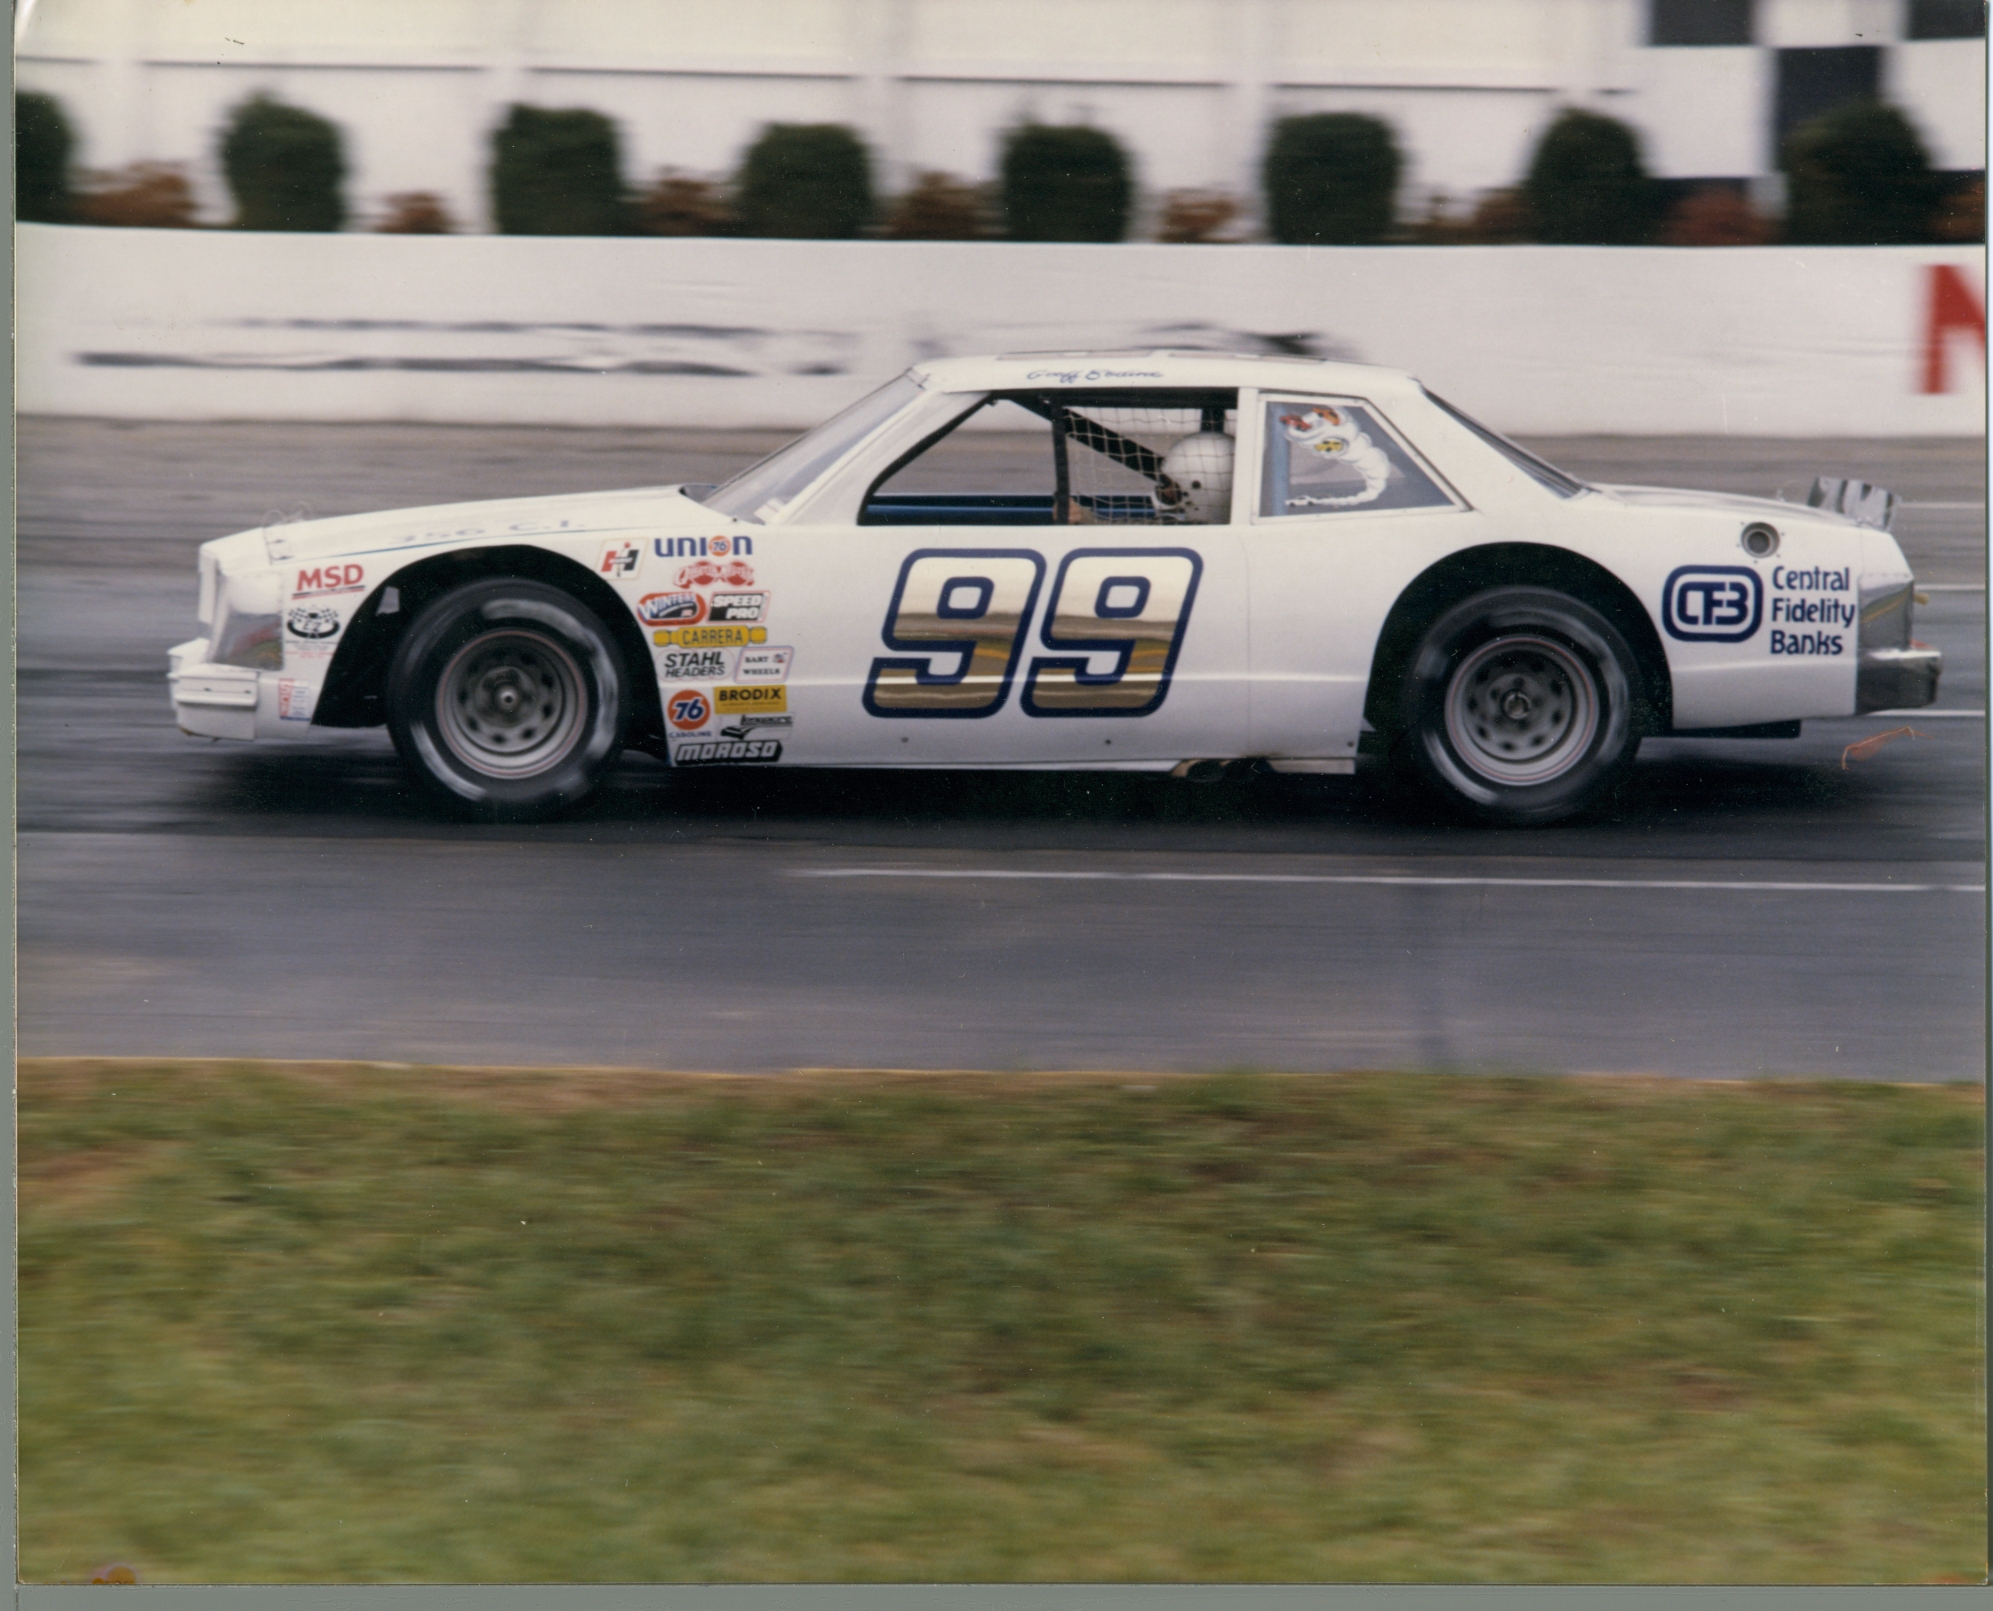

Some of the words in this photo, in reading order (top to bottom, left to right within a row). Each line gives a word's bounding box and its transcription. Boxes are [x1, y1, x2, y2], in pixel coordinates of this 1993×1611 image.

[297, 564, 364, 592] MSD
[1772, 566, 1850, 591] Central
[712, 594, 762, 608] SPEED
[726, 607, 758, 620] PRO
[1772, 598, 1855, 628] Fidelity
[682, 628, 743, 646] CARRERA
[862, 547, 1204, 719] 99
[1770, 630, 1843, 656] Banks
[665, 651, 725, 668] STAHL
[665, 665, 725, 678] HEADERS
[719, 688, 782, 702] BRODIX
[674, 697, 705, 721] 76
[676, 741, 778, 761] MOROSO
